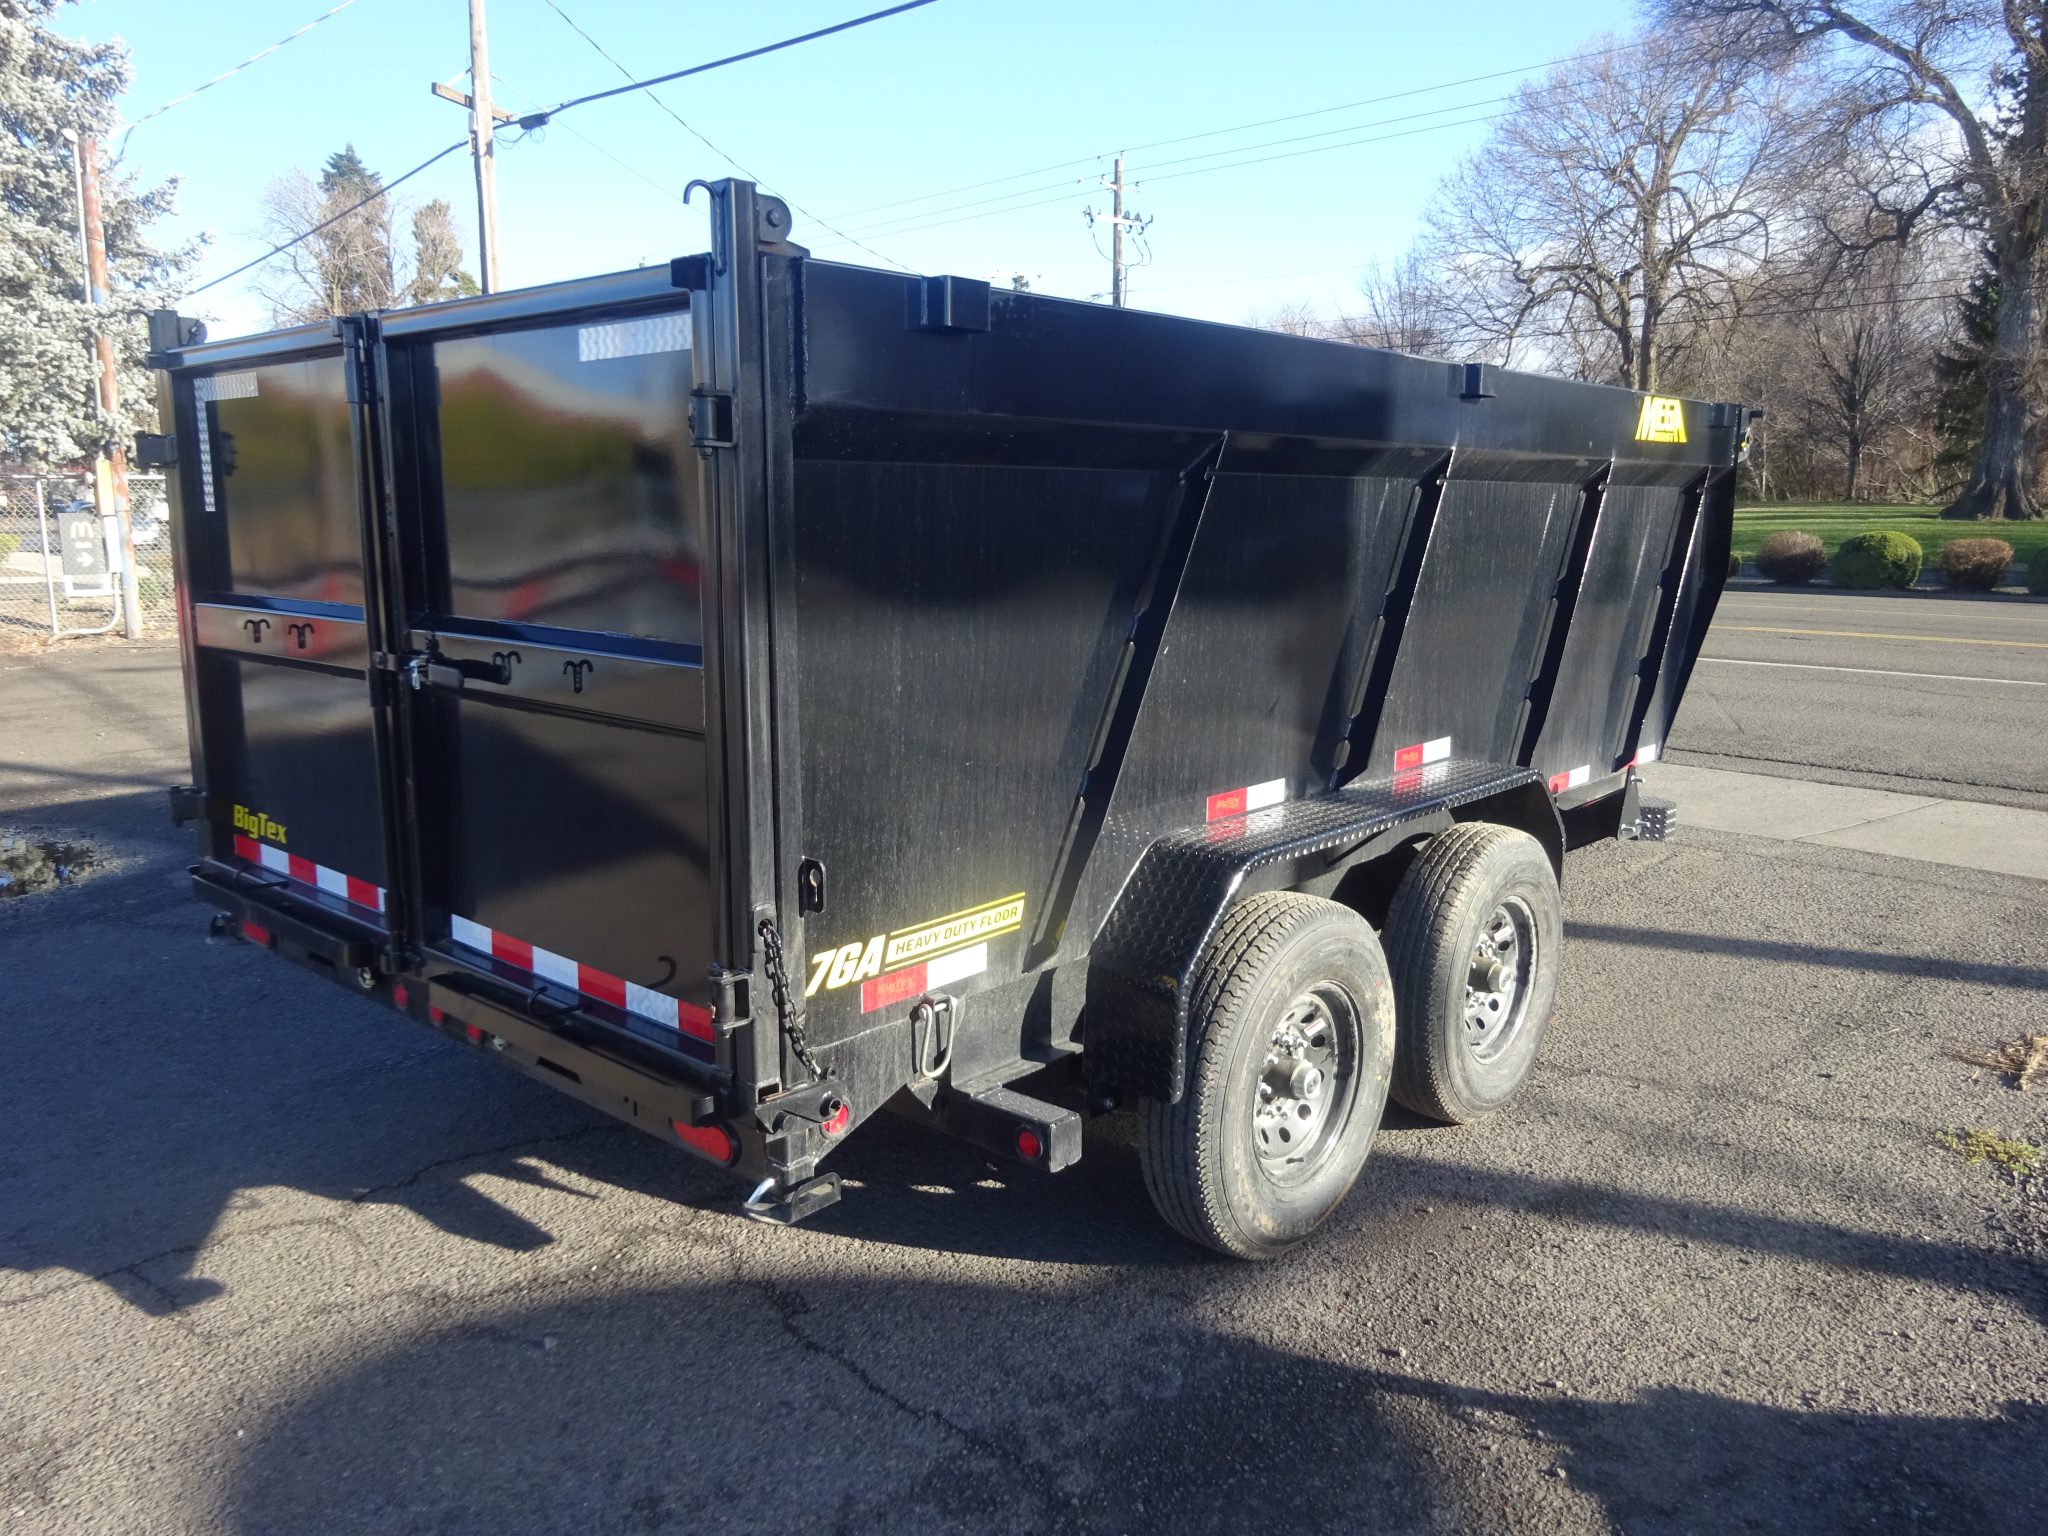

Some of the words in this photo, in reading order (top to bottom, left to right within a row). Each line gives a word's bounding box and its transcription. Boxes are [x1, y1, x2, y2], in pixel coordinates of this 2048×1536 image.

[233, 804, 287, 844] BigTex
[895, 930, 942, 955] HEAVY
[944, 920, 979, 940] DUTY
[980, 906, 1019, 930] FLOOR
[805, 934, 886, 997] 7GA
